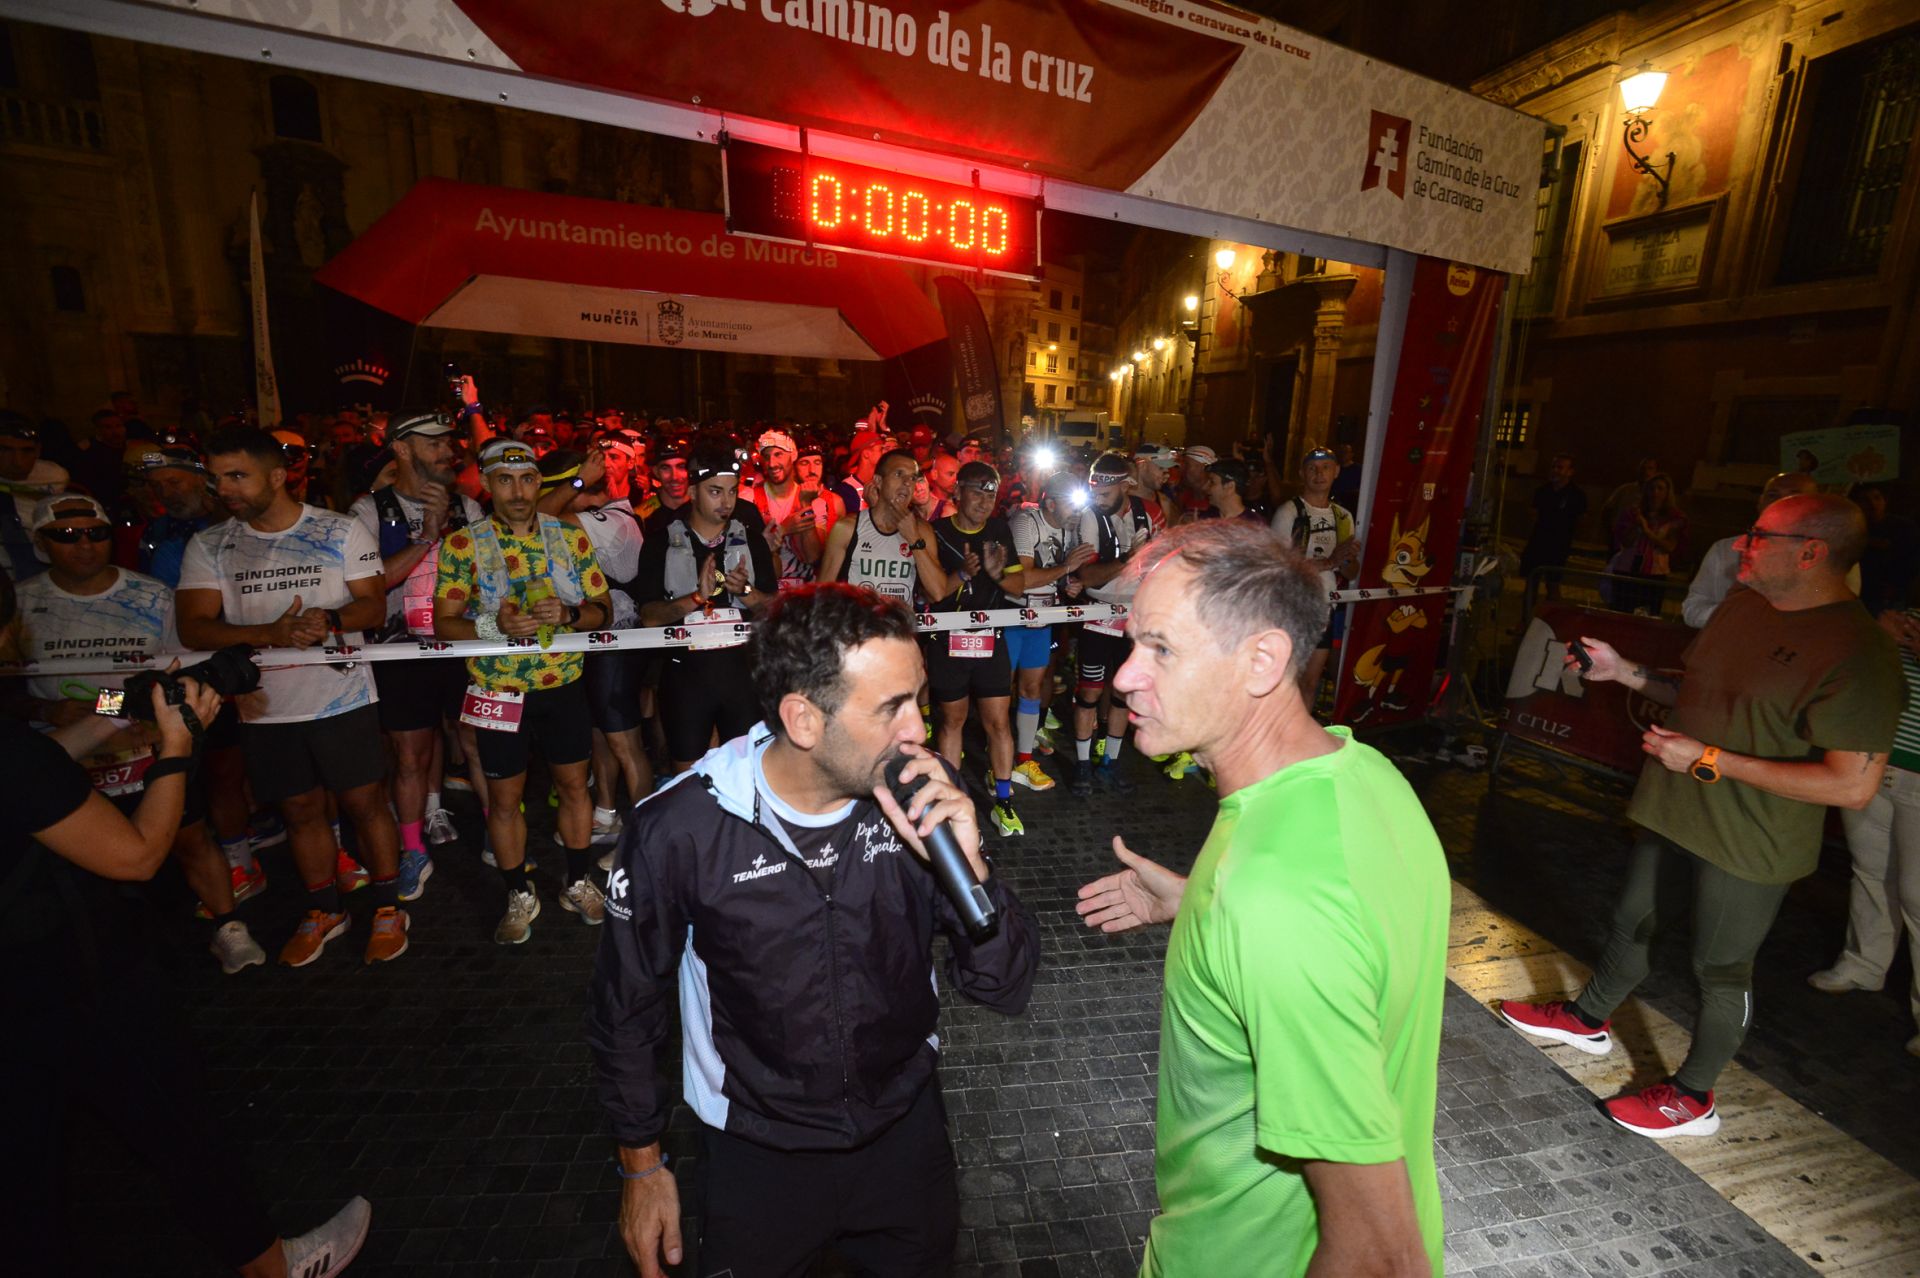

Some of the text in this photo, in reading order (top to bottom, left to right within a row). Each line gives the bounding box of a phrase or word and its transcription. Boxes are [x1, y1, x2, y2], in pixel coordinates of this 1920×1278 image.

[1188, 11, 1251, 39] caravaca
[1253, 30, 1268, 45] de
[1270, 36, 1282, 50] la
[1284, 43, 1312, 60] cruz
[927, 10, 971, 72] de
[979, 23, 1011, 84] la
[1021, 49, 1094, 103] cruz
[1418, 125, 1483, 163] Fundación
[1417, 151, 1521, 199] Camino de la Cruz
[1413, 176, 1484, 213] de Caravaca
[812, 174, 1008, 255] 0:00:00
[475, 207, 838, 269] Ayuntamiento de Murcia
[688, 316, 753, 332] Ayuntamiento
[688, 329, 738, 341] de Murcia
[859, 558, 913, 579] UNED
[241, 578, 322, 595] DE USHER
[970, 611, 990, 623] 90k
[587, 631, 618, 645] 90k
[664, 627, 692, 641] 90k
[961, 637, 983, 649] 339
[473, 700, 504, 718] 264
[1517, 711, 1573, 738] cruz
[732, 860, 788, 884] TEAMERGY
